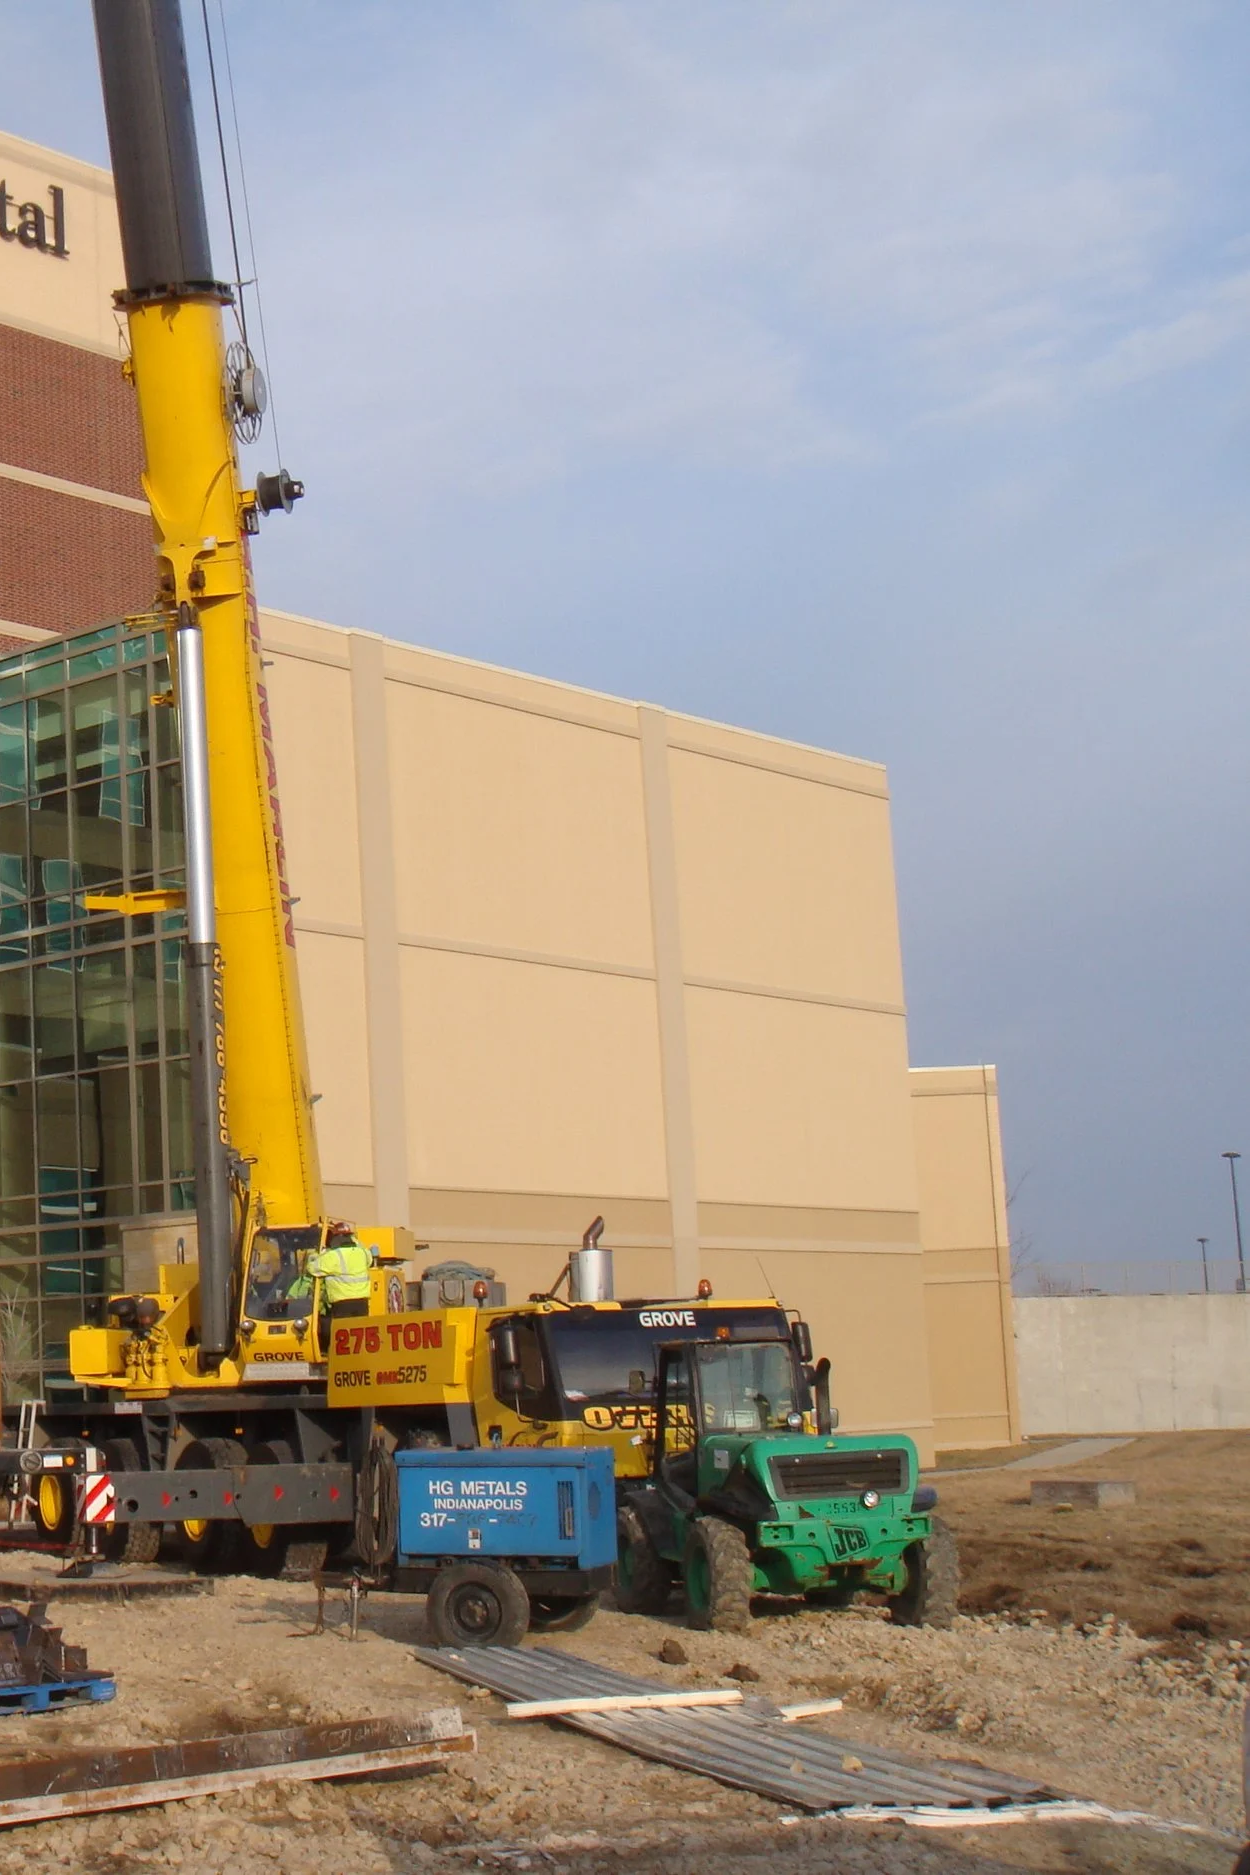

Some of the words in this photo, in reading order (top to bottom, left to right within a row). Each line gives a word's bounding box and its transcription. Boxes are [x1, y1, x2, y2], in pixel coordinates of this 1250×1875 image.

[639, 1310, 696, 1327] GROVE
[335, 1326, 381, 1355] 275
[387, 1320, 443, 1351] TON
[253, 1351, 305, 1362] GROVE
[334, 1370, 371, 1387] GROVE
[428, 1480, 453, 1496] HG
[460, 1480, 527, 1496] METALS
[433, 1498, 523, 1511] INDIANAPOLIS
[833, 1528, 867, 1558] JCB
